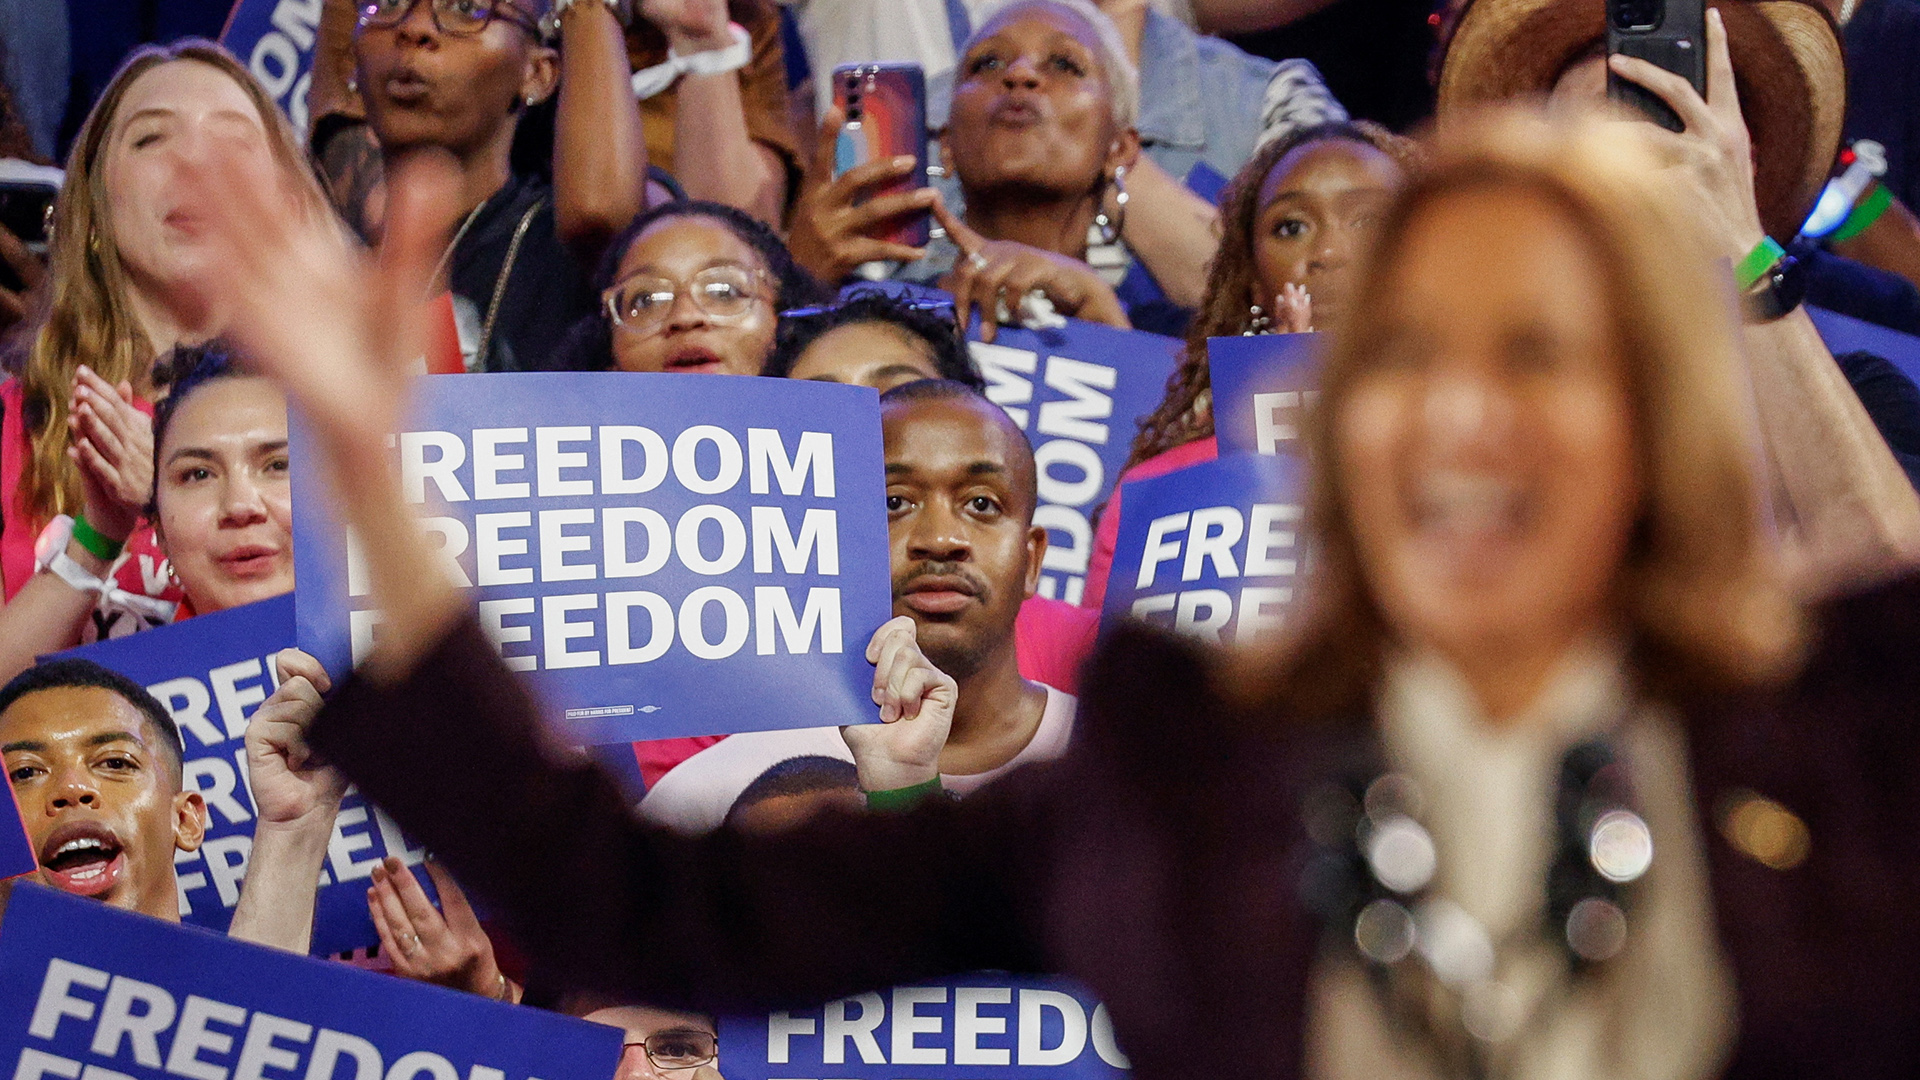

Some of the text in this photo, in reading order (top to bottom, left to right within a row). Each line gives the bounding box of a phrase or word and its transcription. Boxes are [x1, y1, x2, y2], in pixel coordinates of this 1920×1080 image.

[386, 424, 836, 503] REEDOM
[1135, 503, 1317, 590] FRE
[350, 585, 843, 672] FEEDOM
